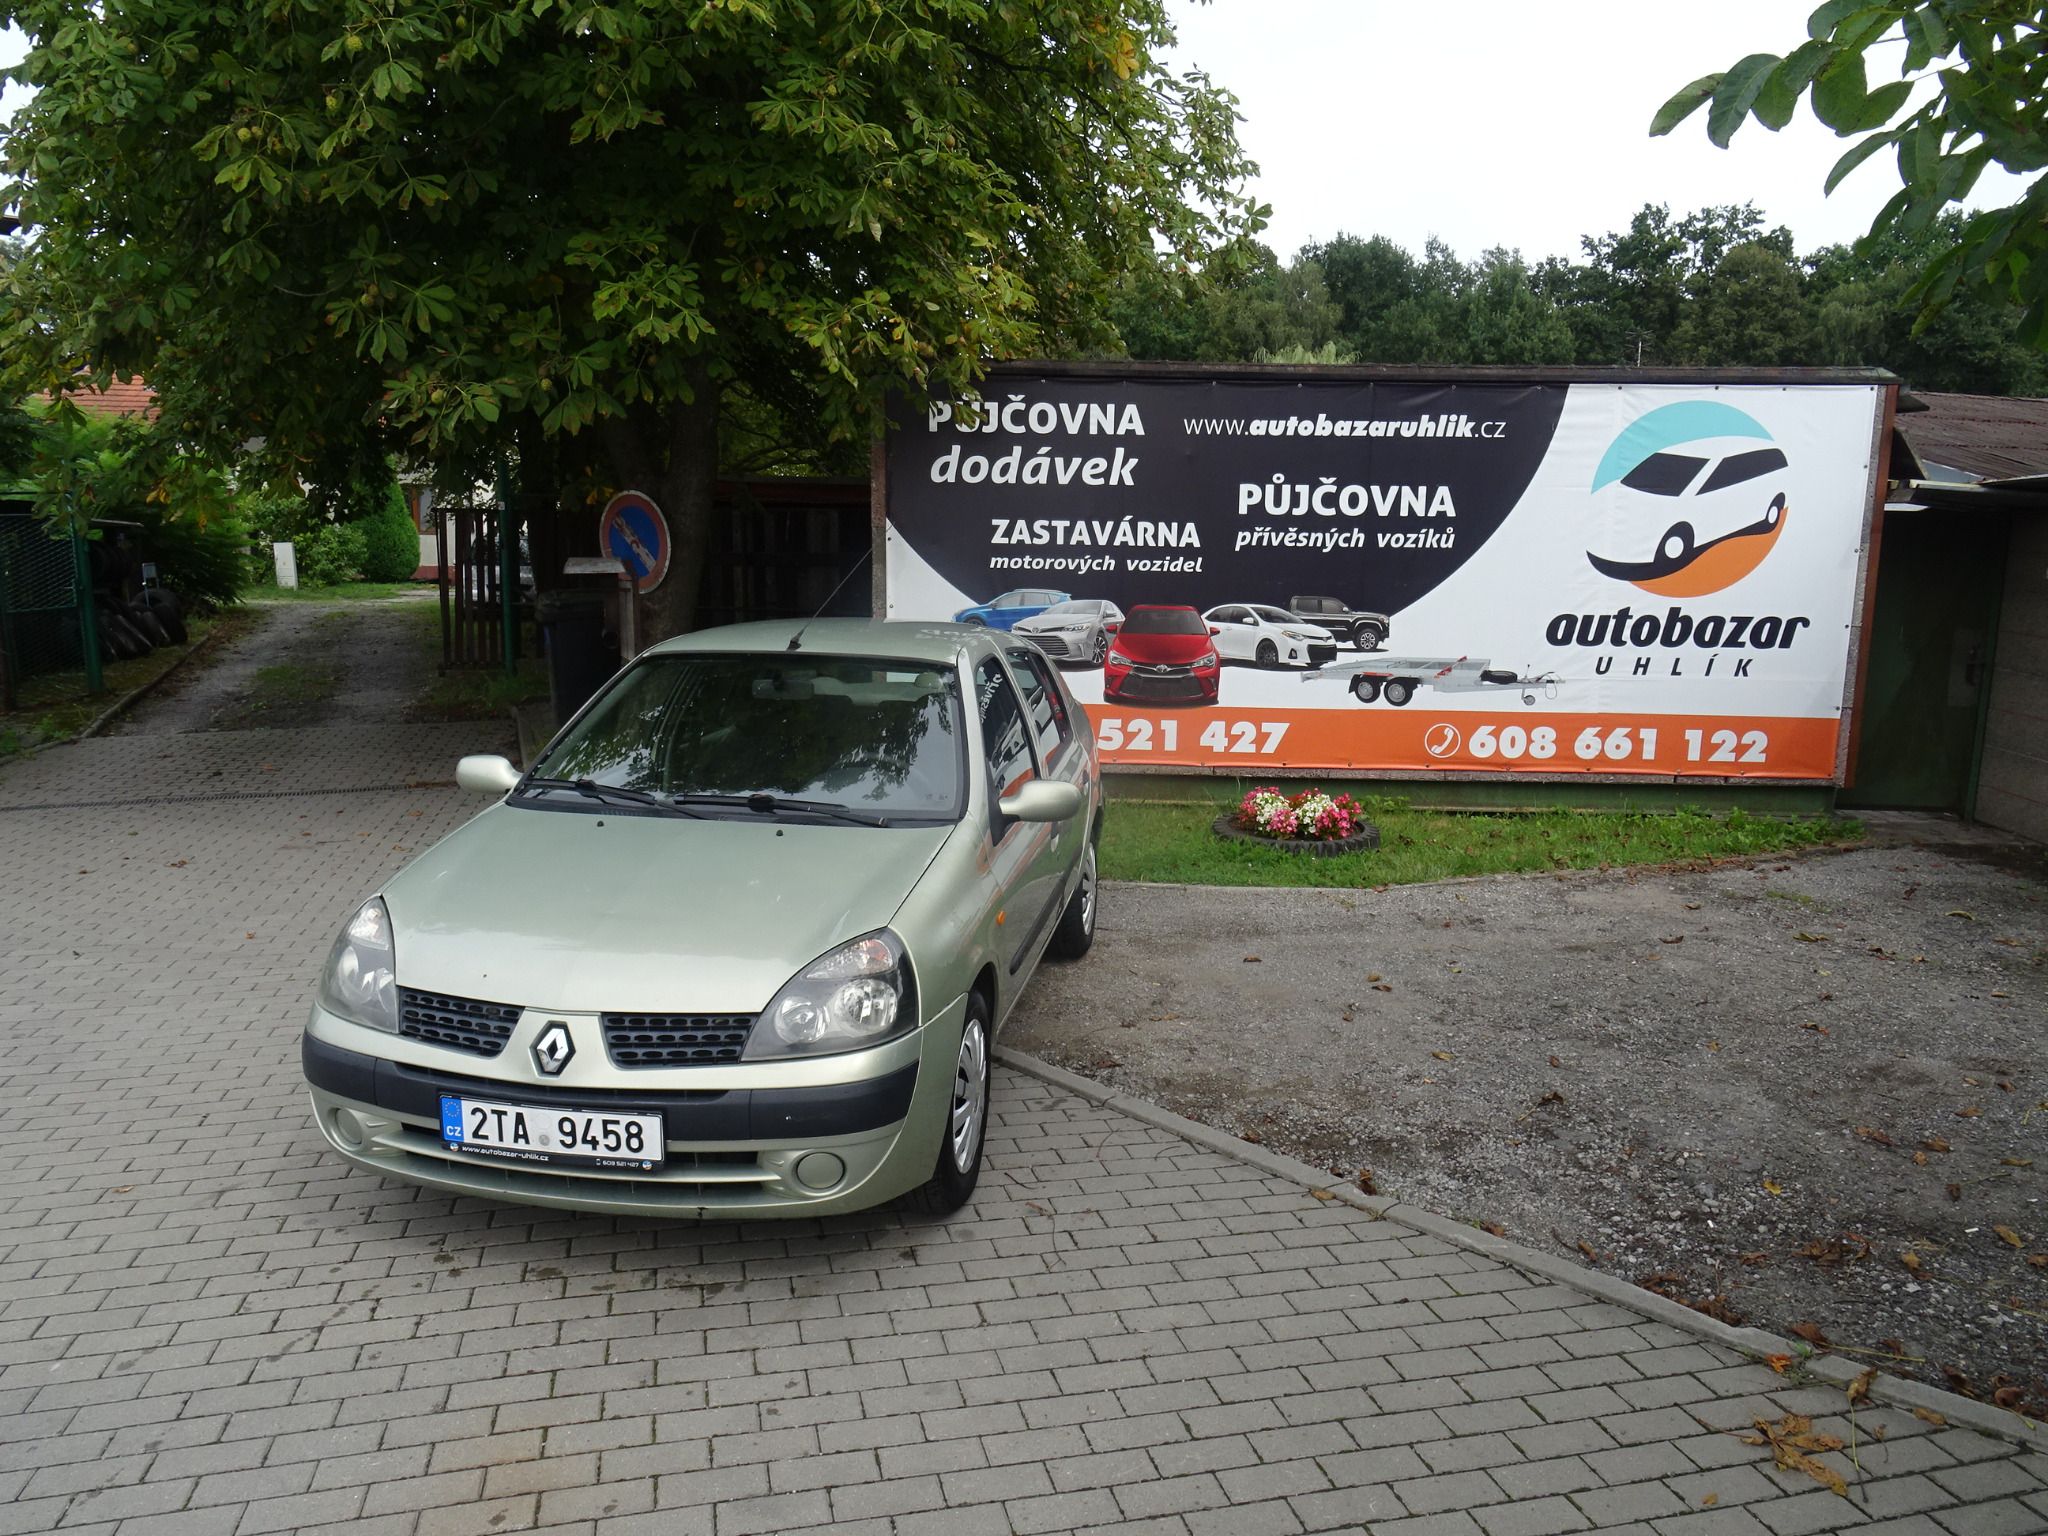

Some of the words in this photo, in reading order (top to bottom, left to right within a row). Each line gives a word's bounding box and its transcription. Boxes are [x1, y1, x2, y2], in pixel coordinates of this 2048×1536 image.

[1183, 414, 1506, 439] www.autobazaruhlik.cz
[930, 445, 1138, 486] dodávek
[1238, 473, 1456, 517] PŮJČOVNA
[991, 516, 1200, 548] ZASTAVÁRNA
[1235, 527, 1365, 553] přívěsných
[1377, 527, 1455, 549] vozíků
[989, 556, 1115, 575] motorových
[1127, 557, 1202, 573] vozidel
[1546, 606, 1811, 649] autobazar
[1595, 654, 1753, 677] UHLÍK
[1097, 718, 1178, 751] 521
[1200, 721, 1290, 754] 427
[1468, 725, 1557, 759] 608
[1574, 726, 1658, 760] 661
[1685, 729, 1768, 763] 122
[446, 1125, 462, 1137] CZ
[470, 1107, 531, 1145] 2TA
[558, 1116, 644, 1153] 9458
